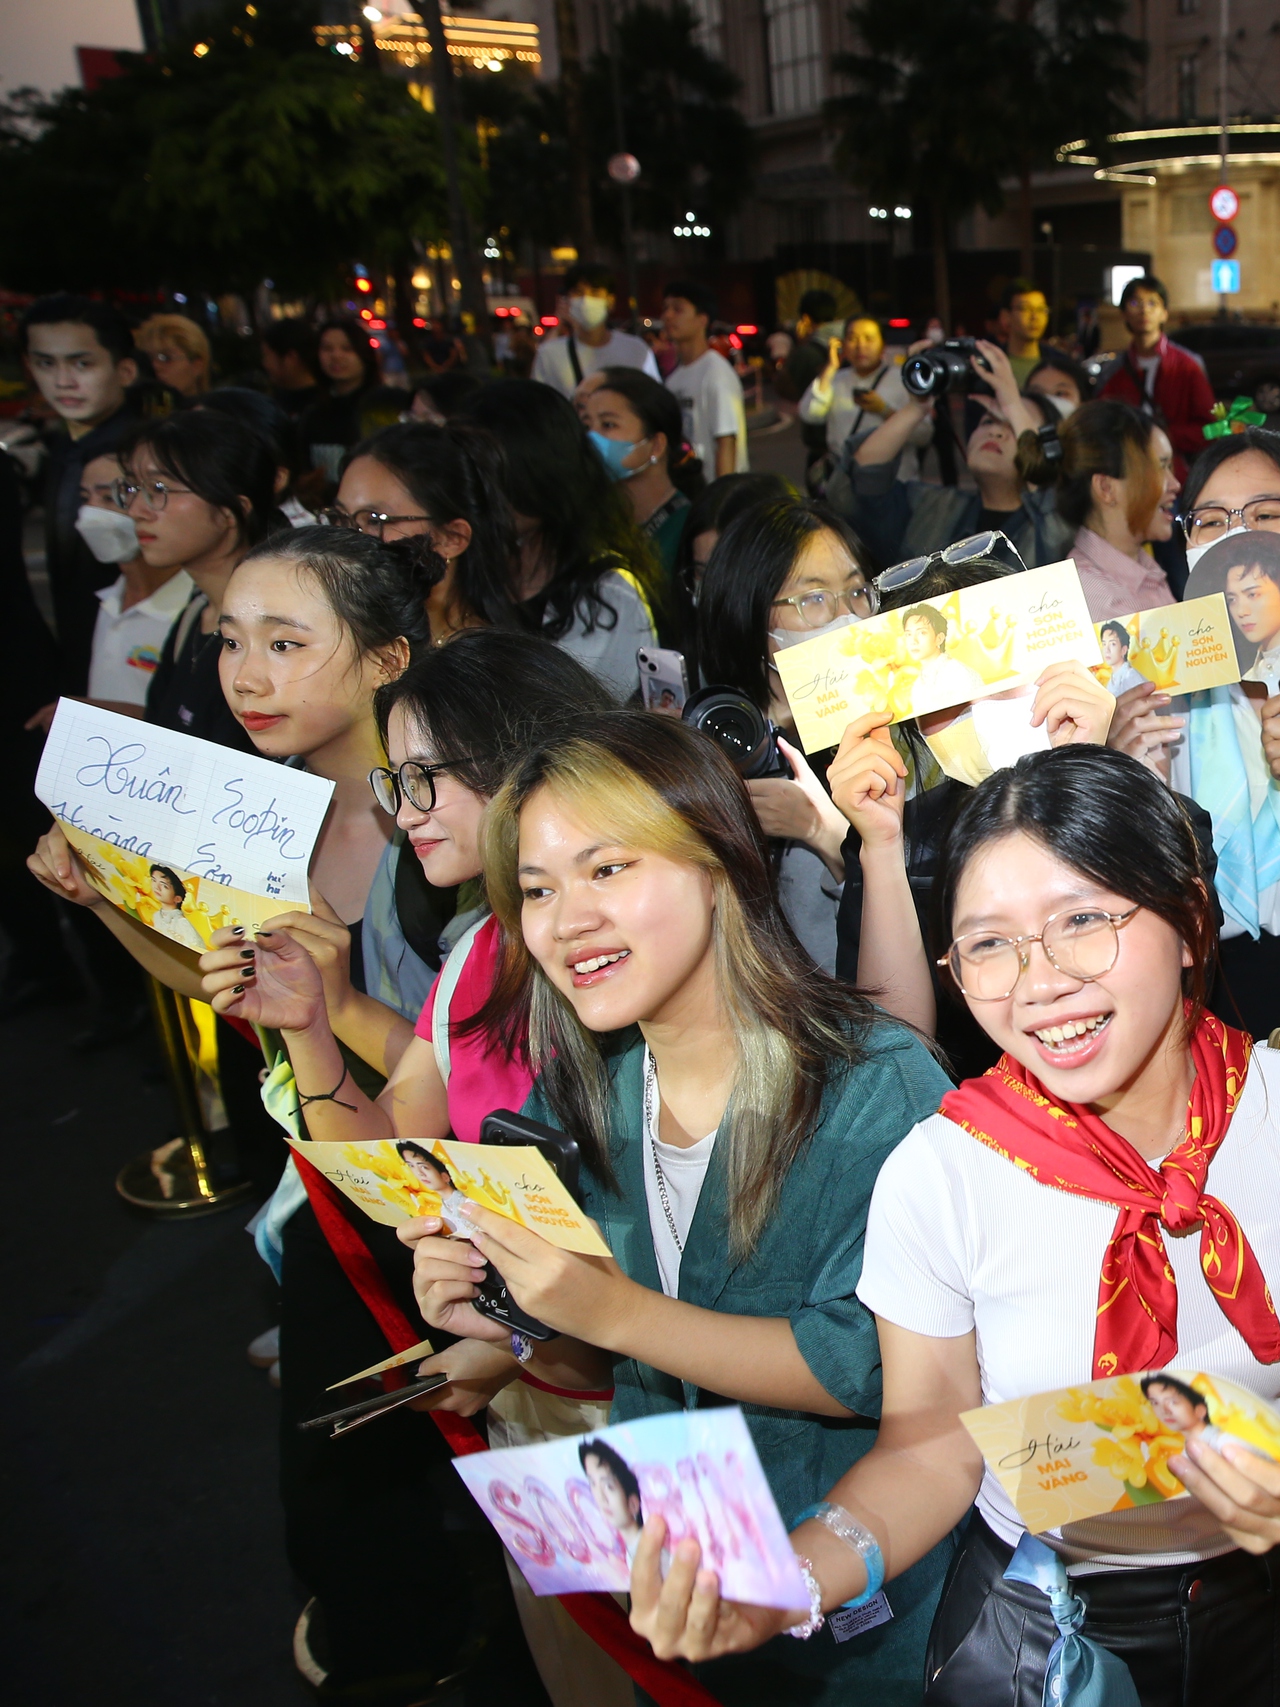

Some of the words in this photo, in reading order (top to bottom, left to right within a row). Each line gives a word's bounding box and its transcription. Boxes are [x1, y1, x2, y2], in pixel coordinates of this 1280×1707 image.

[1028, 591, 1063, 614] cho
[1188, 618, 1215, 636] cho
[816, 689, 840, 704] MAI
[815, 699, 849, 719] VÀNG
[76, 736, 197, 815] Xuân
[1037, 1457, 1072, 1475] MAI
[1038, 1471, 1088, 1491] VÀNG
[835, 1613, 852, 1622] NEW
[853, 1599, 878, 1616] DESIGN
